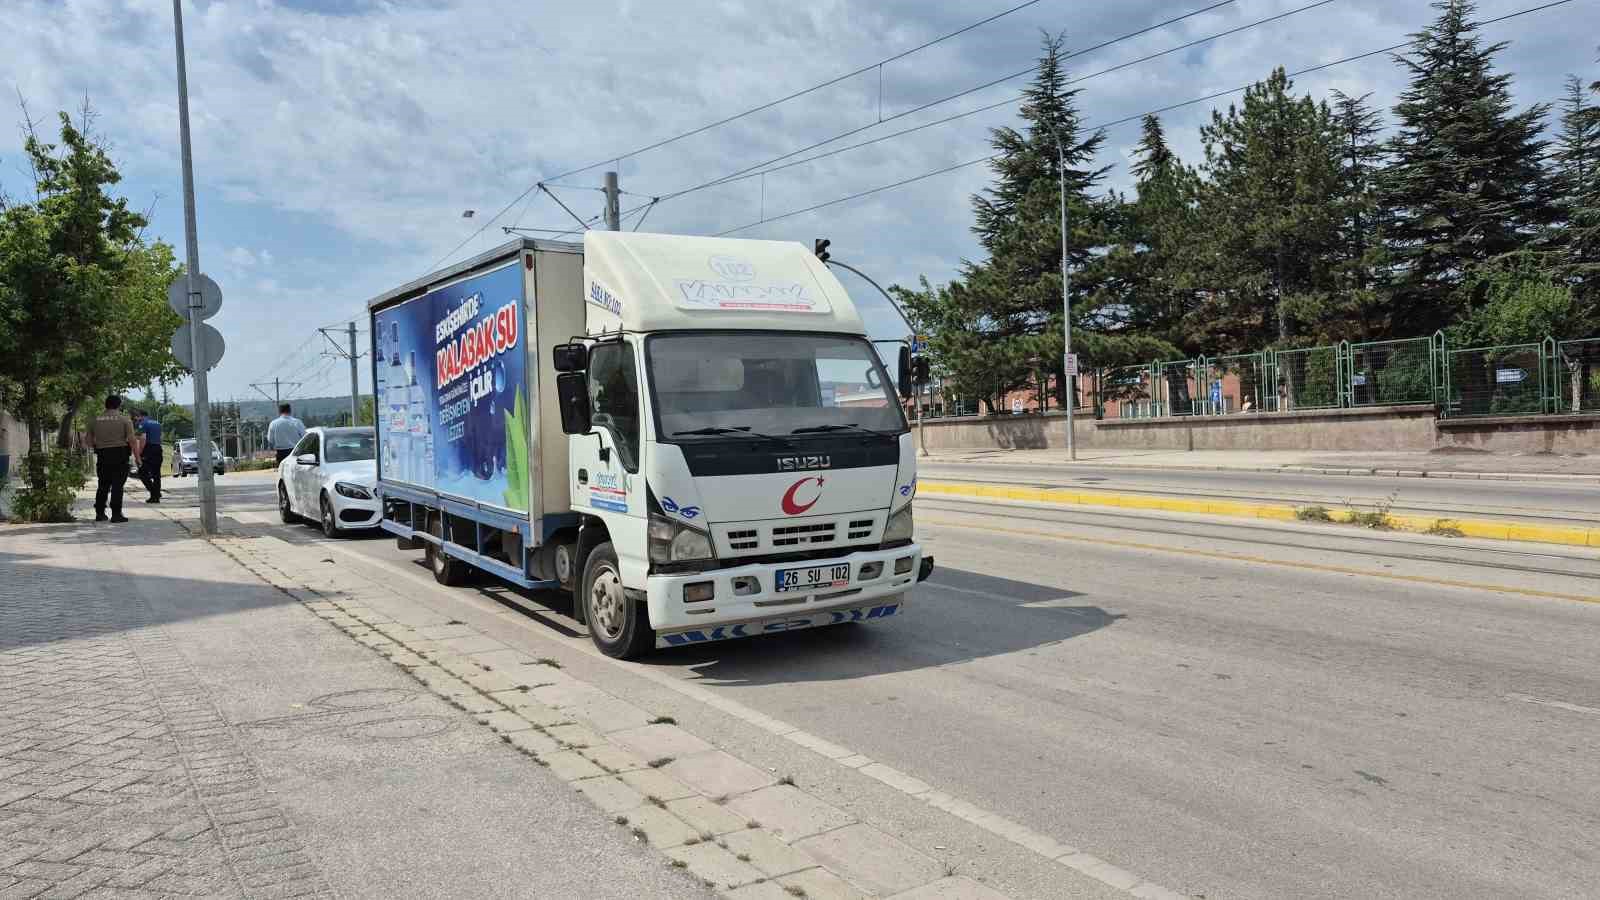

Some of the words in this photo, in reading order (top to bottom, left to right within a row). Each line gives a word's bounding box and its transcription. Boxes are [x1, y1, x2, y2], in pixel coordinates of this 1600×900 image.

[437, 313, 496, 390] KALABAK
[496, 300, 518, 354] SU
[777, 456, 831, 471] ISUZU
[785, 572, 798, 585] 26
[808, 569, 821, 583] SU
[831, 566, 848, 580] 102
